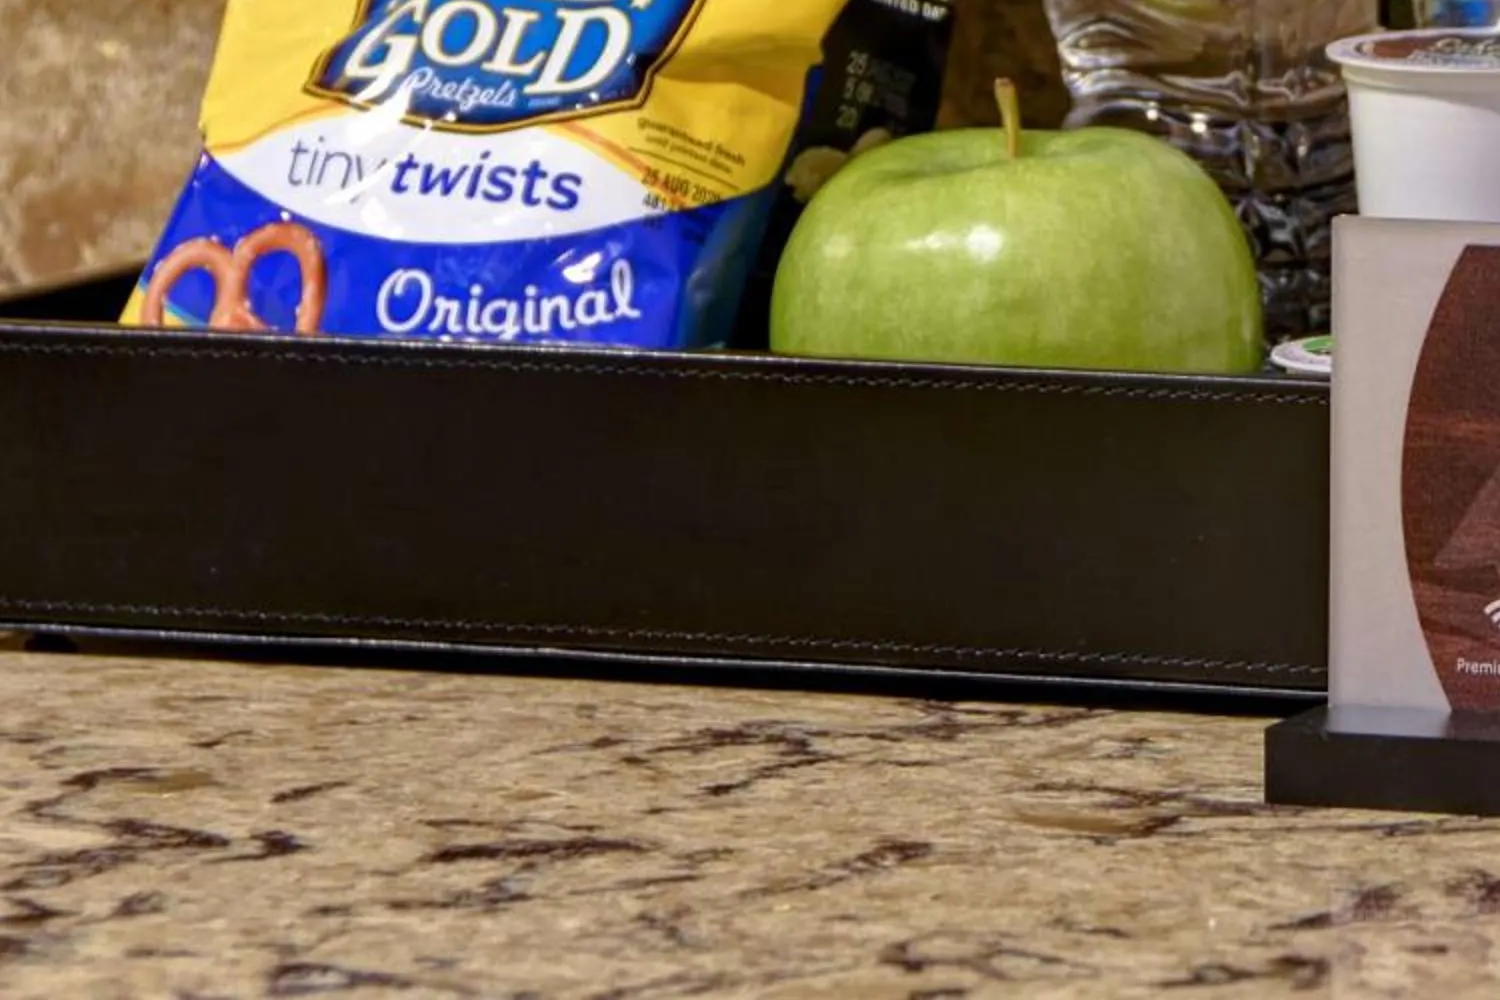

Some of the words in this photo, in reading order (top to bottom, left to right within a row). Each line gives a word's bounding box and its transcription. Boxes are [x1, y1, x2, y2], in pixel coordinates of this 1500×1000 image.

[407, 66, 517, 111] Pretzels
[287, 136, 387, 204] tiny
[390, 151, 582, 210] twists
[376, 258, 641, 340] Original
